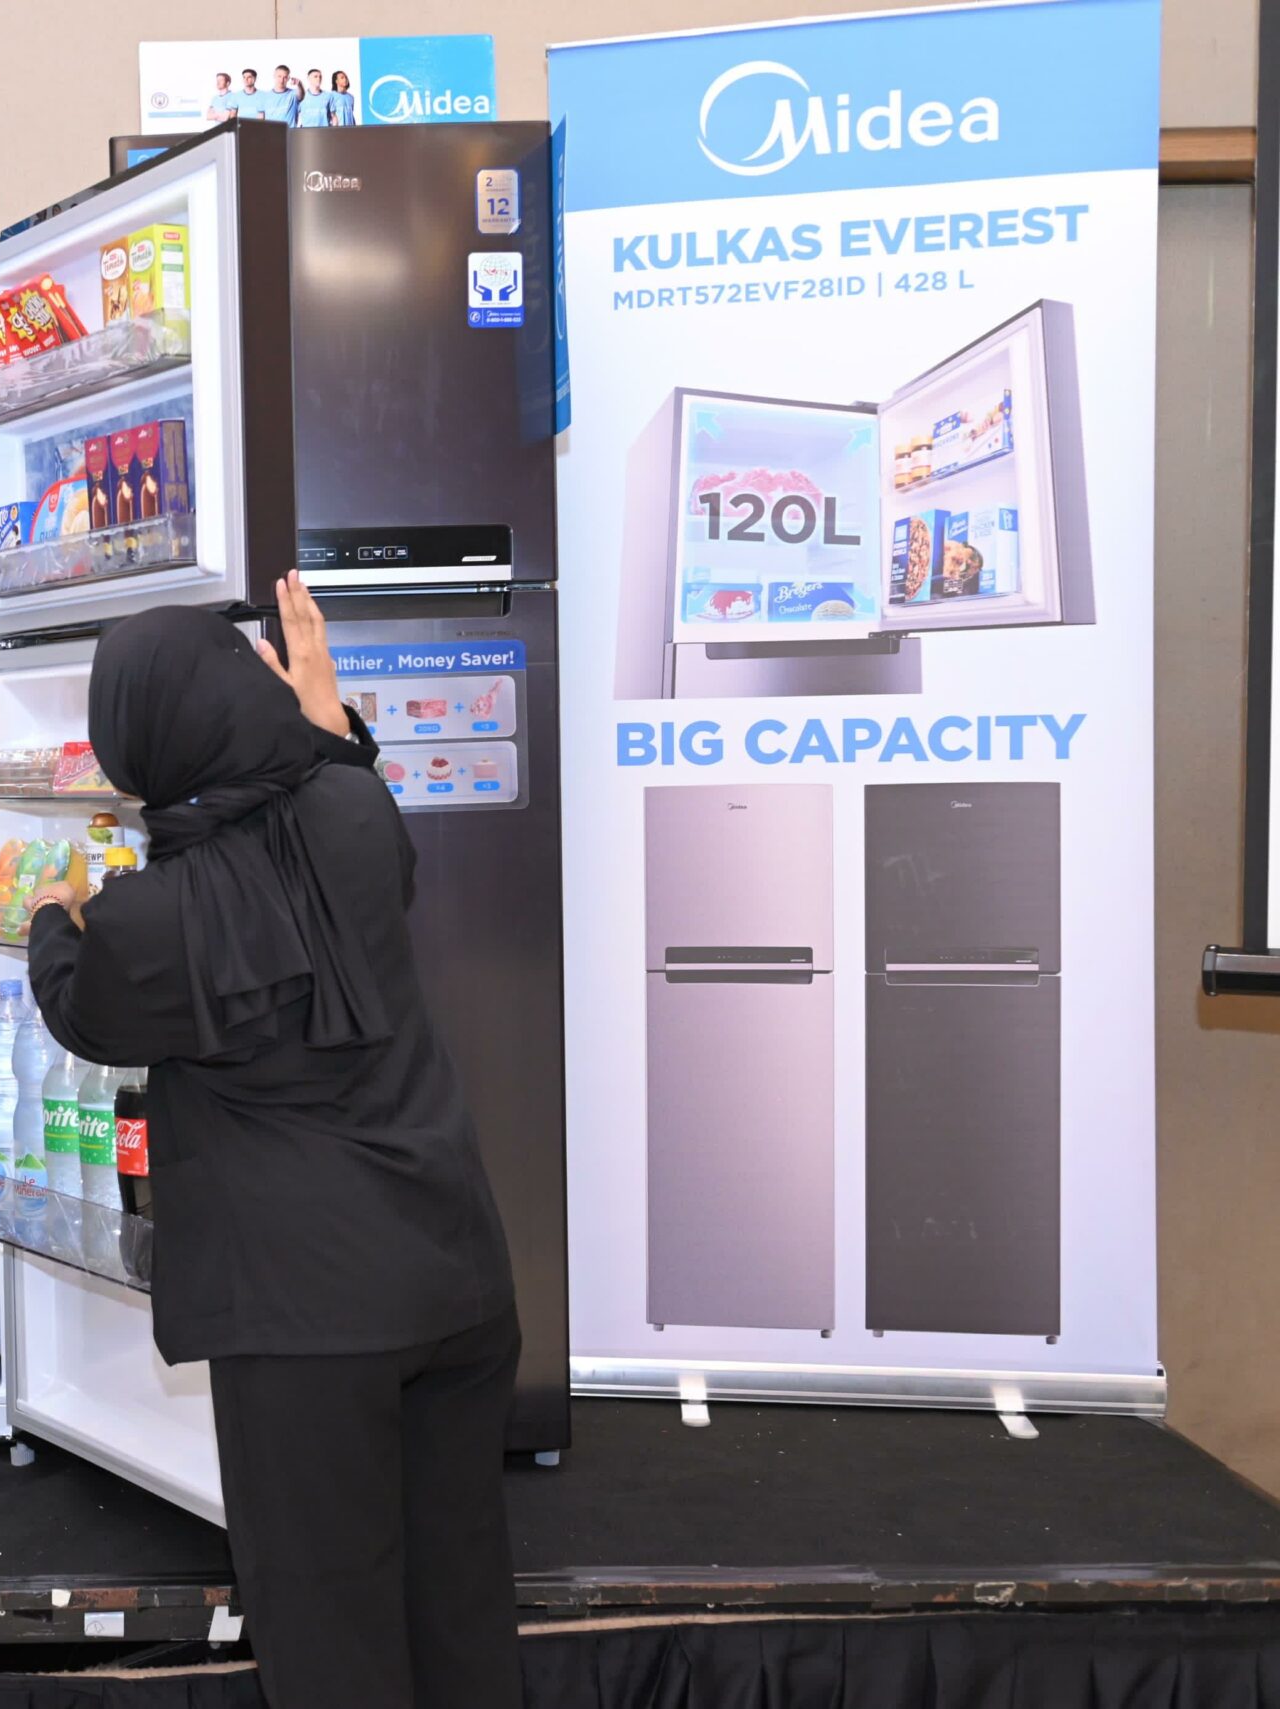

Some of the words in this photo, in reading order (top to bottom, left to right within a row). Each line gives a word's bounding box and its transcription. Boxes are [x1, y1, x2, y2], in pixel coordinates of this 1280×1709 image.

[369, 74, 490, 122] Midea
[698, 60, 1000, 176] Midea
[485, 177, 493, 187] 2
[487, 198, 510, 215] 12
[613, 224, 822, 273] KULKAS
[840, 205, 1089, 258] EVEREST
[613, 275, 865, 311] MDRT572EVF28ID
[895, 271, 947, 294] 428
[959, 269, 974, 289] L
[698, 492, 861, 546] 120L
[332, 656, 384, 671] lthier
[398, 654, 456, 669] Money
[460, 651, 515, 666] Saver!
[616, 719, 724, 766] BIG
[744, 713, 1087, 765] CAPACITY
[43, 1105, 80, 1128] prite
[80, 1114, 110, 1138] rite
